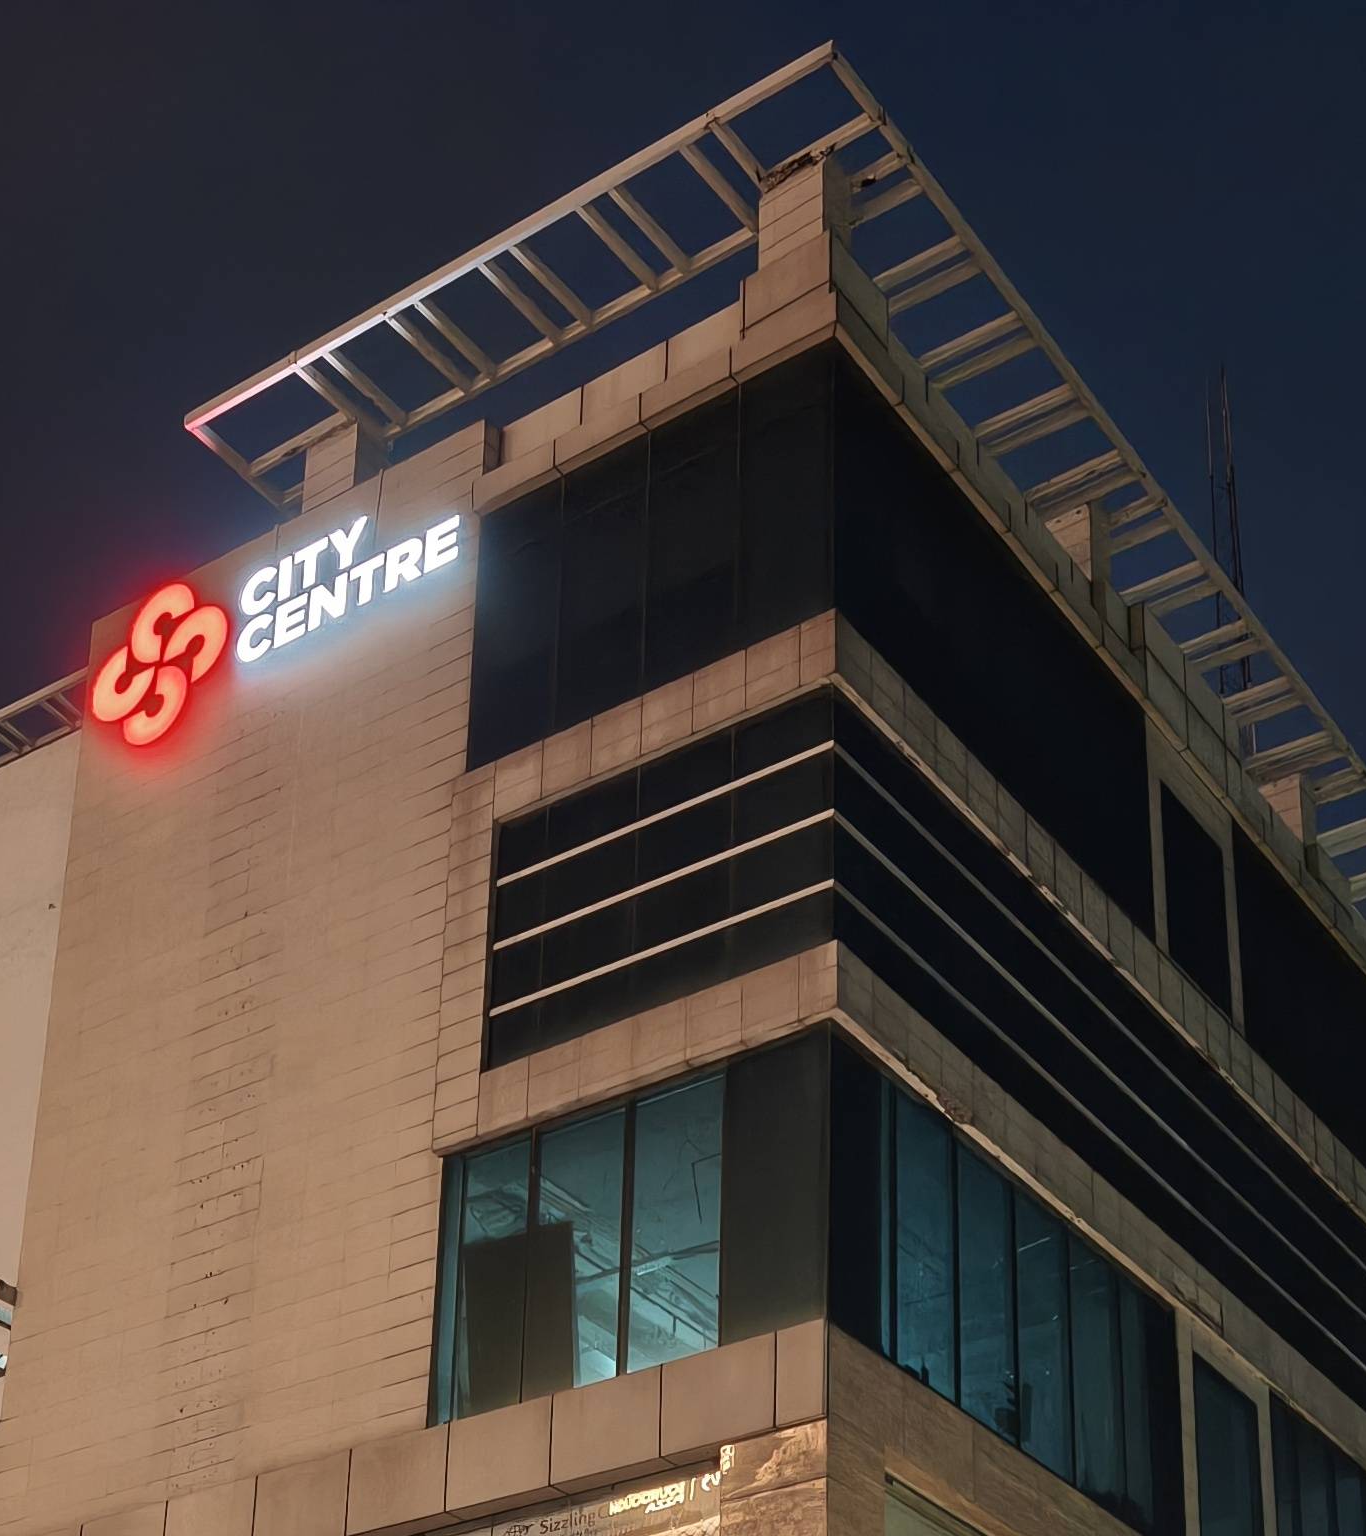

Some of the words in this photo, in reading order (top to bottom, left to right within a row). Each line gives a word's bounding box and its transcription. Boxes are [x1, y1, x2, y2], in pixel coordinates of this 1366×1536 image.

[235, 513, 462, 664] CENTRE
[239, 514, 369, 617] CITY
[539, 1511, 596, 1535] Sizzling
